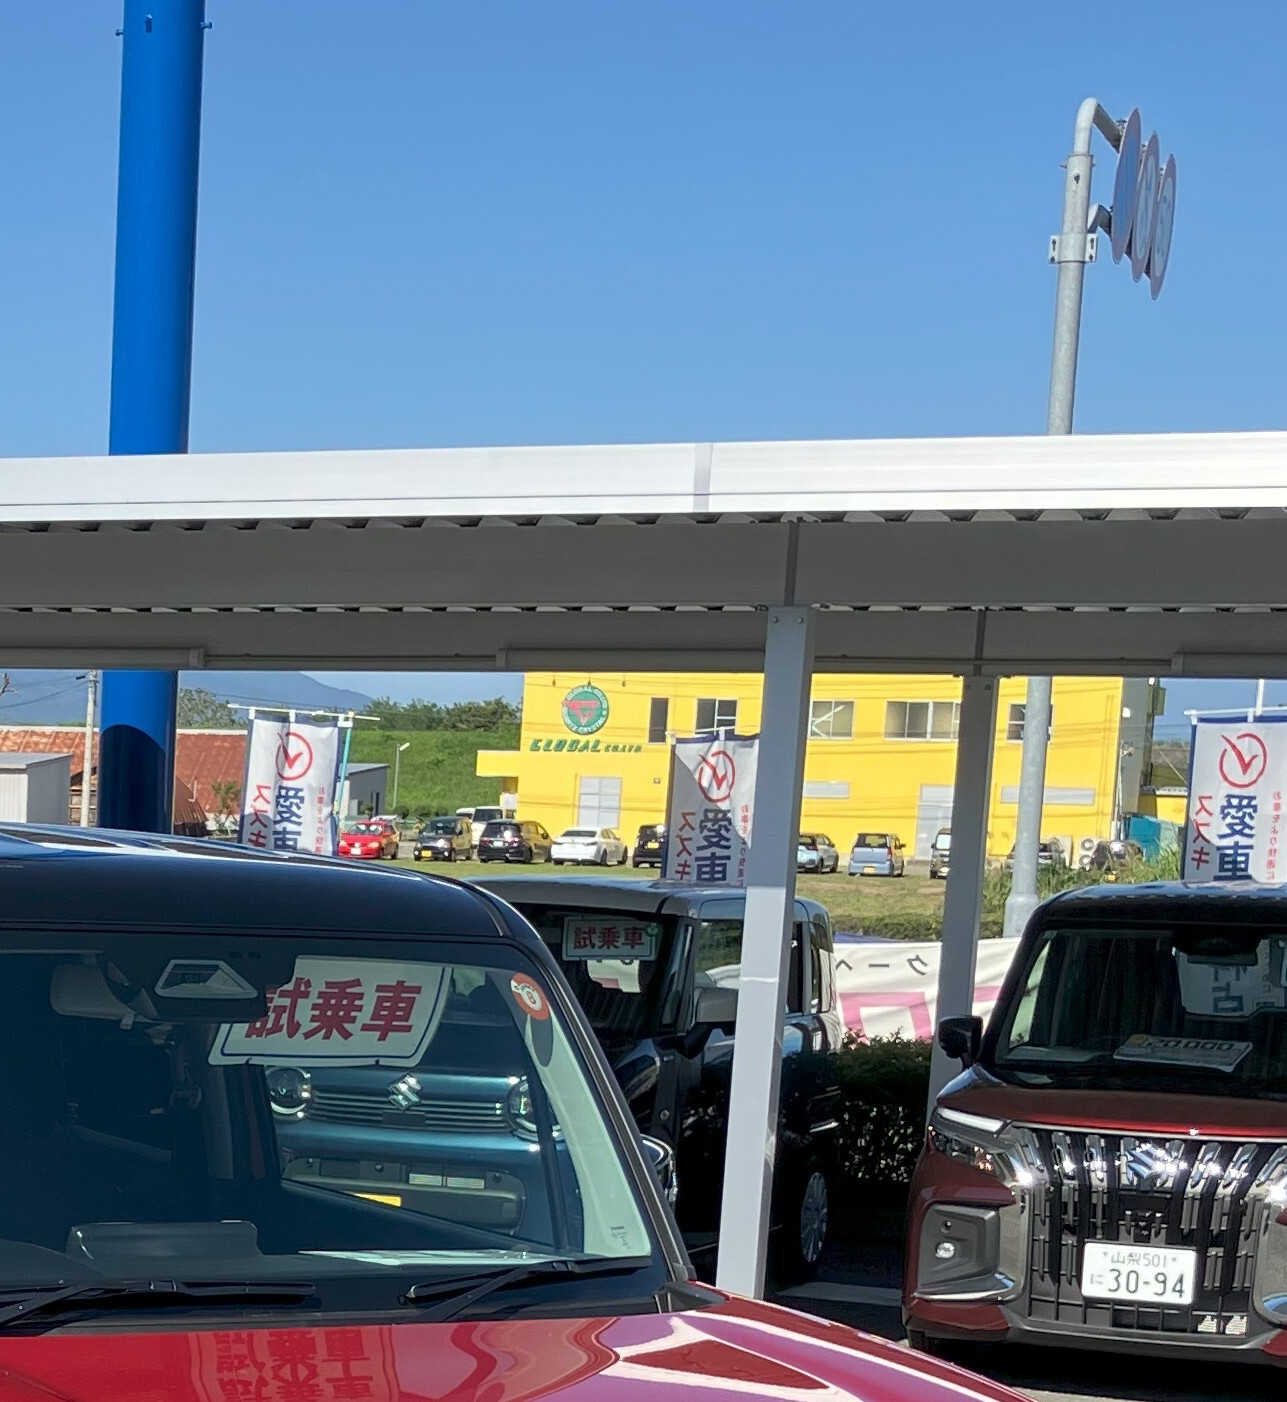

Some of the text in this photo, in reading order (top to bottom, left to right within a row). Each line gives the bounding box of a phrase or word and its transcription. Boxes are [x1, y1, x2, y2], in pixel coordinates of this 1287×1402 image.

[529, 739, 601, 753] GLOBAL
[573, 926, 645, 950] 試乗車
[525, 990, 537, 1005] 8
[244, 976, 423, 1042] 試乗車
[1110, 1251, 1167, 1268] 山梨501
[1090, 1268, 1185, 1299] に 30-94
